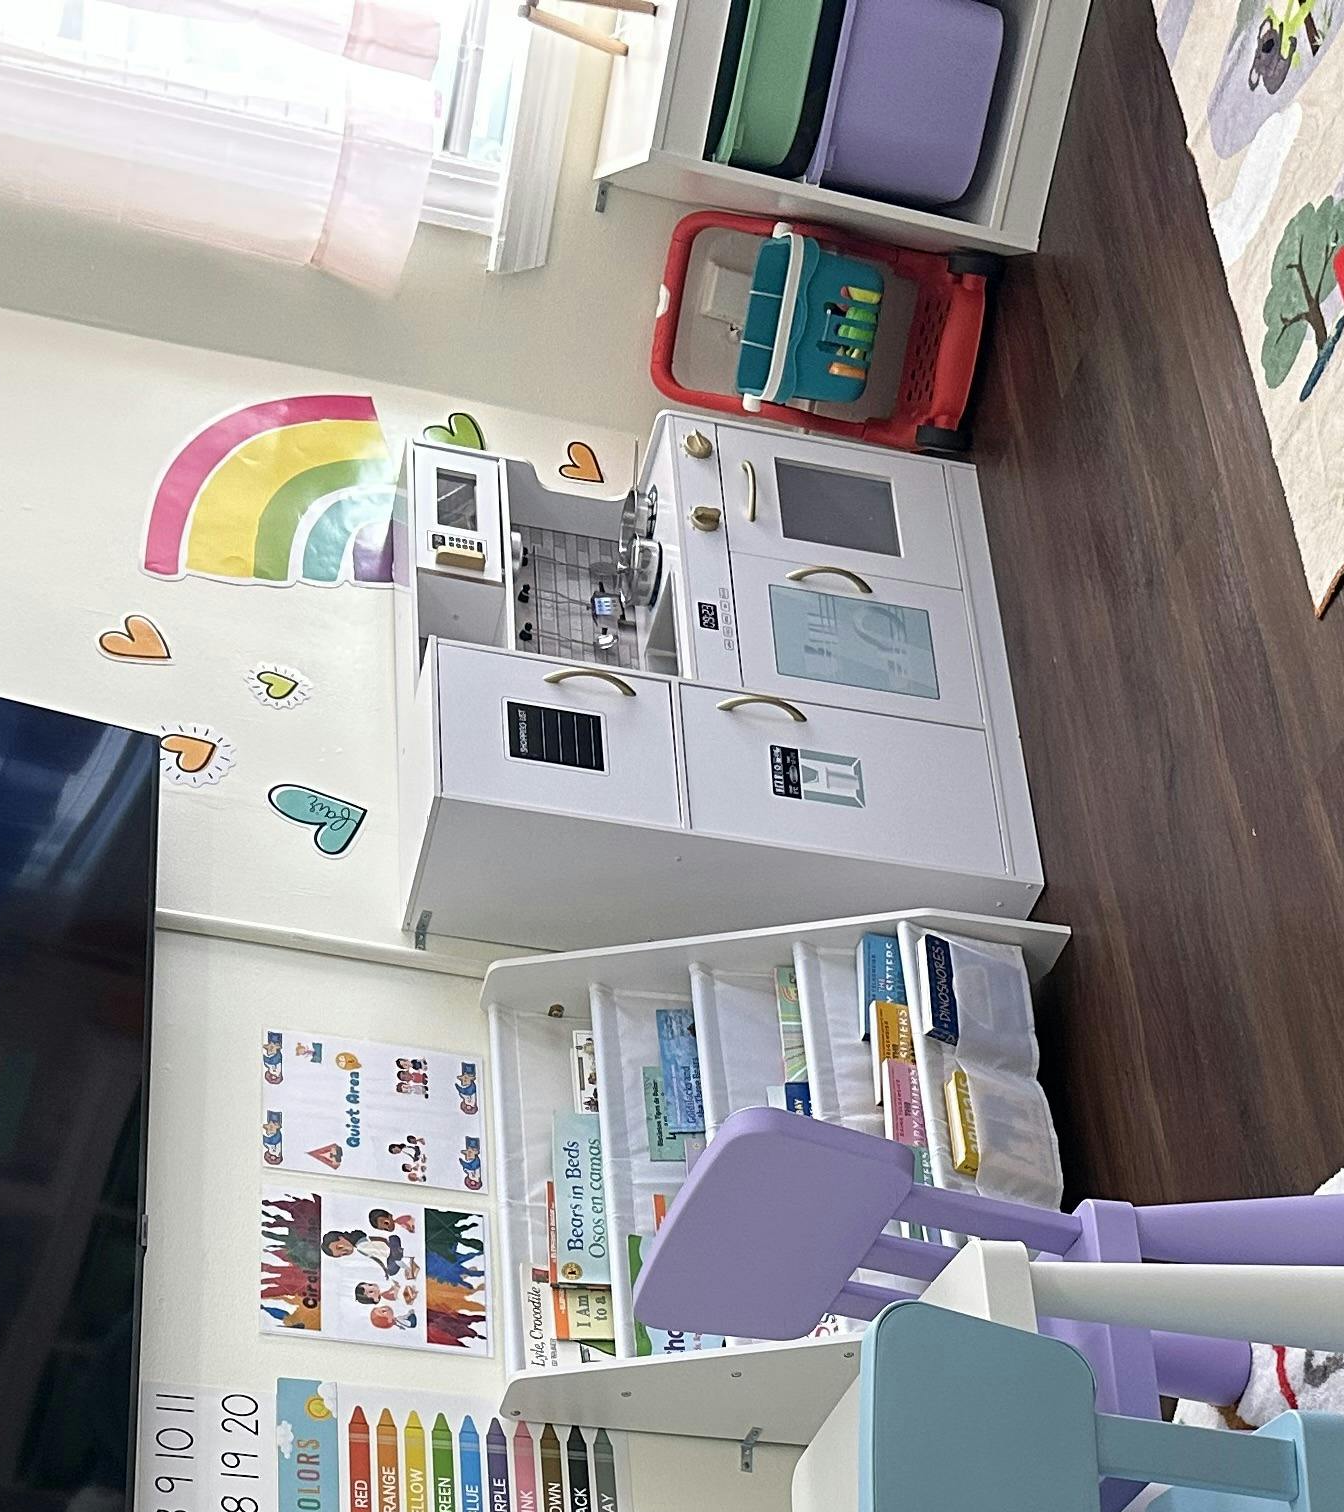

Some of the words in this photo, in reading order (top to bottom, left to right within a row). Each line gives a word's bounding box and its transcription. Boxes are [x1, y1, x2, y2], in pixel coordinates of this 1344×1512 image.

[307, 796, 357, 831] fair
[933, 947, 952, 1021] DINOSNORES
[899, 1010, 908, 1058] SITTERS
[345, 1072, 360, 1104] Area
[681, 1066, 691, 1081] and
[345, 1109, 361, 1147] Quiet
[562, 1141, 581, 1179] Beds
[588, 1138, 604, 1191] camas
[568, 1185, 584, 1199] in
[591, 1197, 603, 1214] en
[567, 1204, 584, 1251] Bears
[588, 1218, 605, 1258] Osos
[527, 1287, 543, 1339] Crocodile
[576, 1295, 590, 1316] Am
[595, 1309, 607, 1320] to
[531, 1342, 548, 1366] Lyle,
[155, 1394, 194, 1413] 11
[221, 1394, 259, 1436] 20
[155, 1428, 194, 1459] 10
[220, 1452, 258, 1479] 19
[154, 1477, 193, 1493] 9
[355, 1480, 369, 1508] RED
